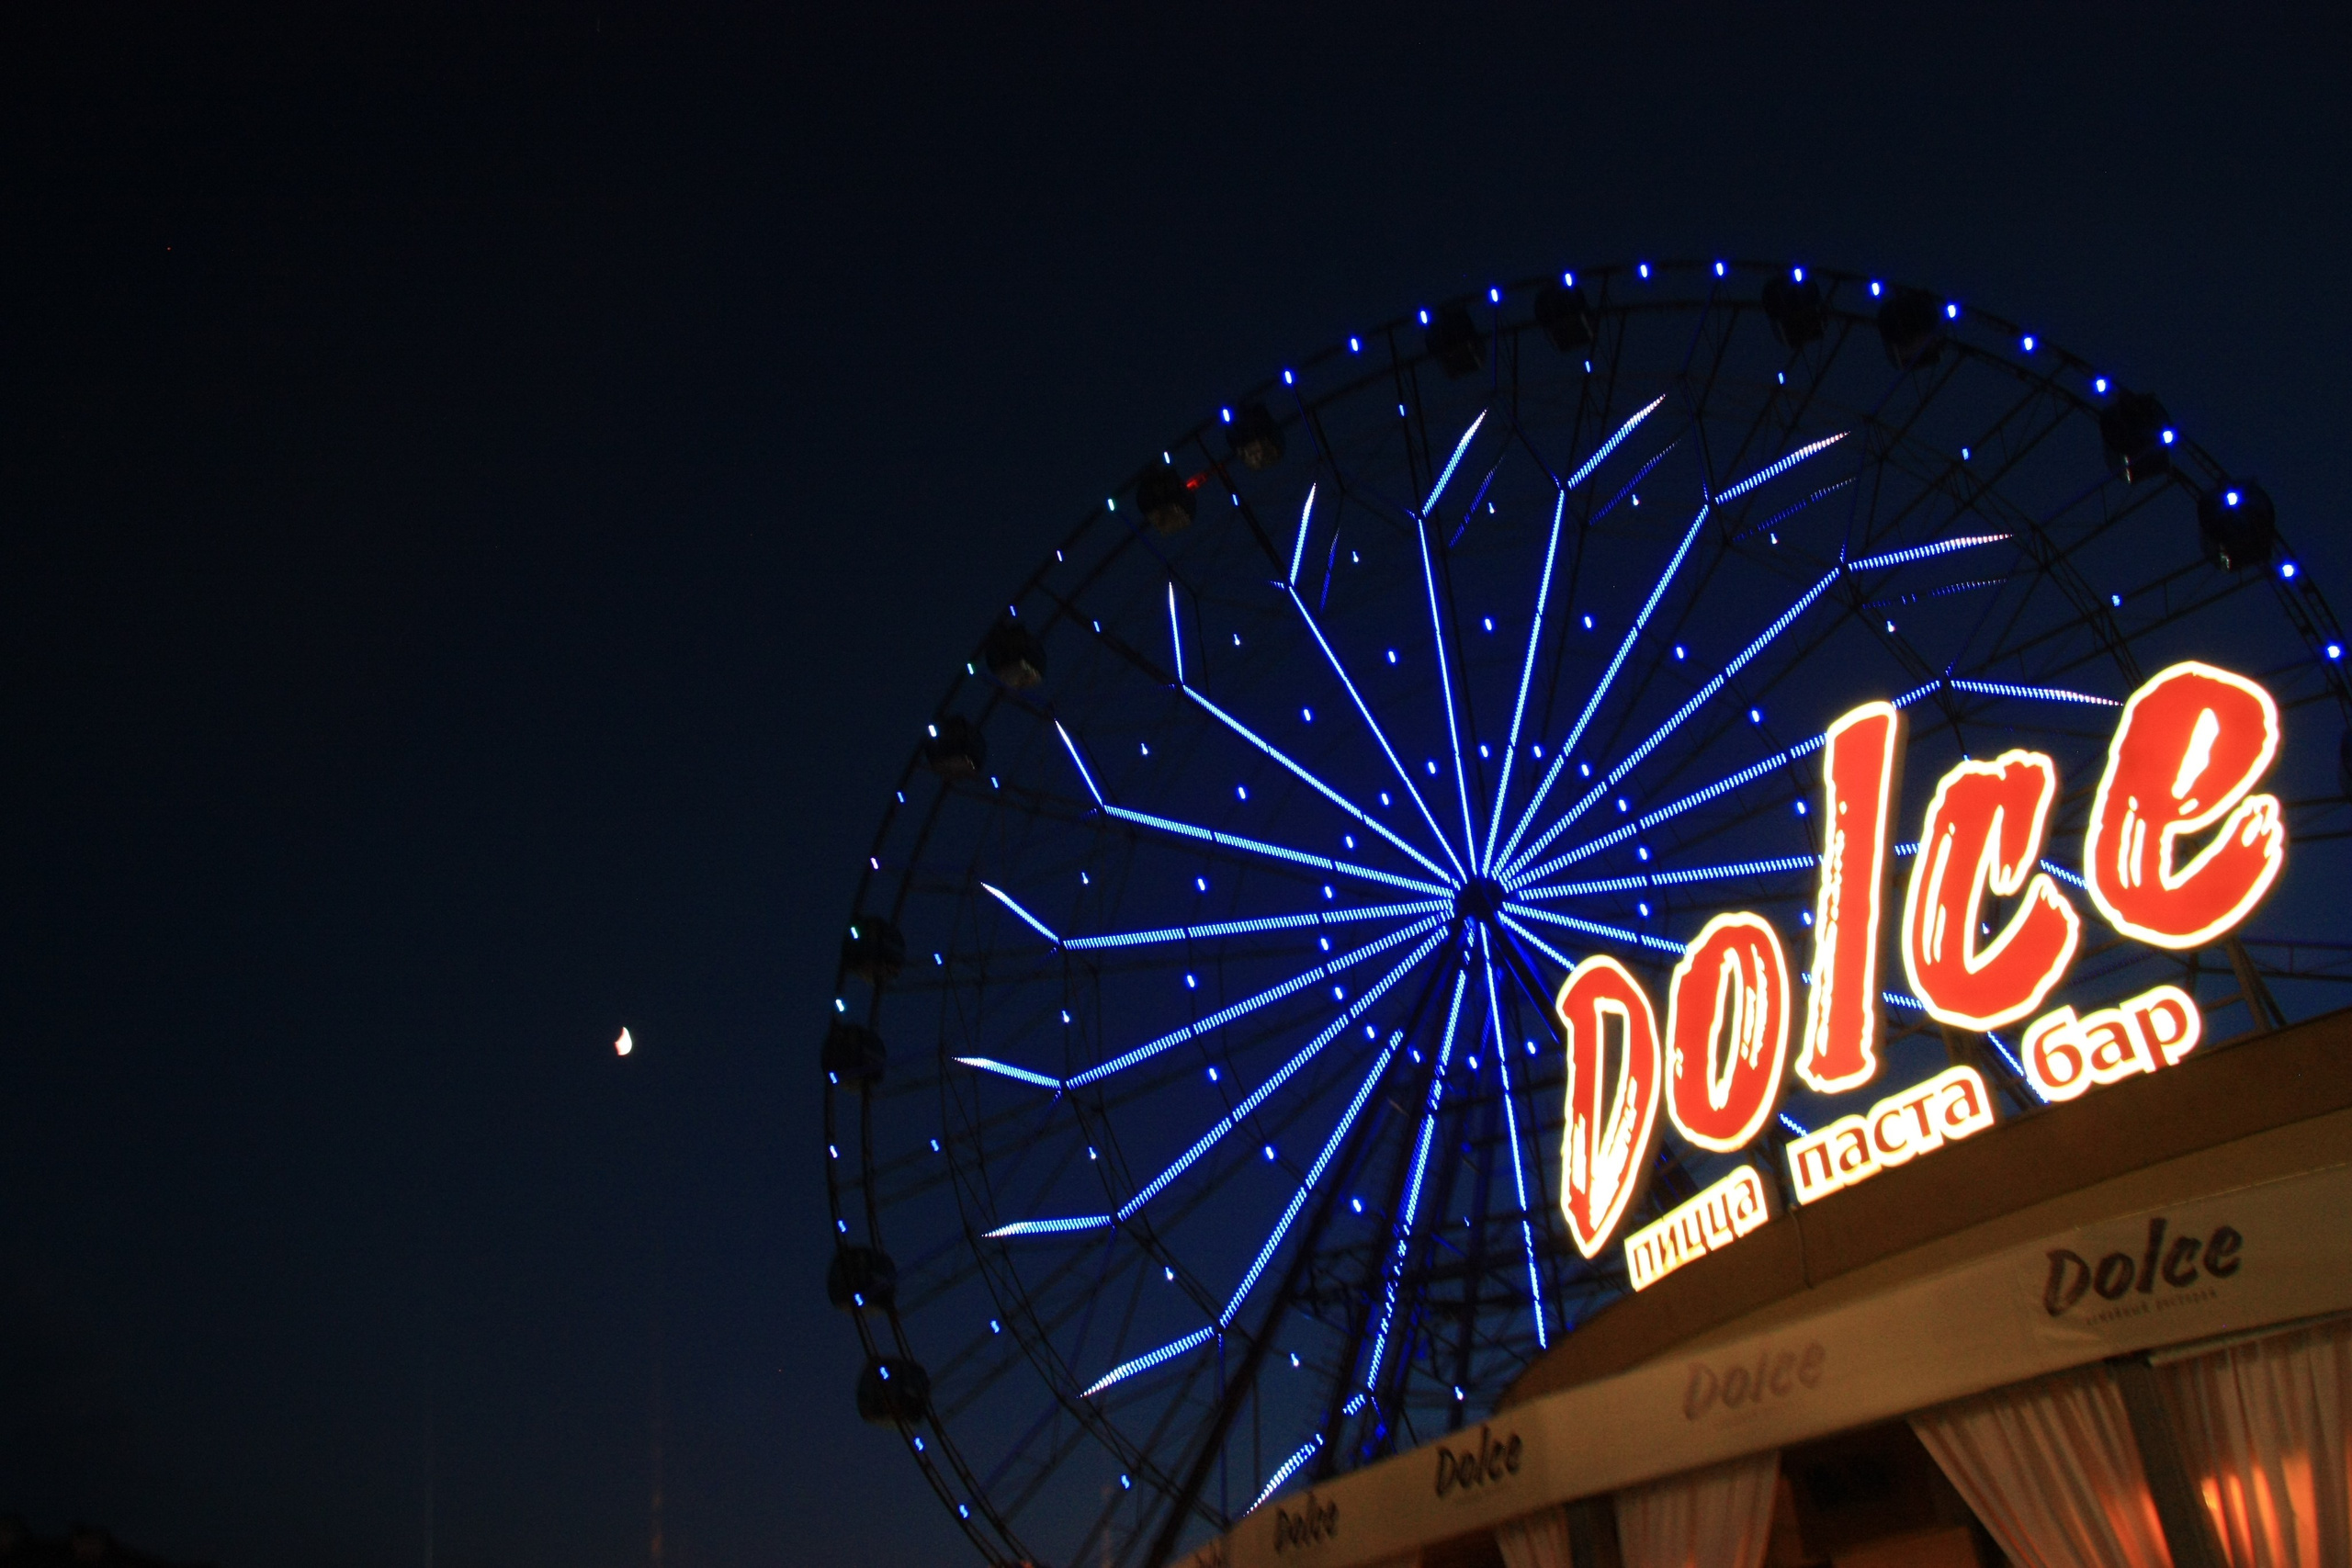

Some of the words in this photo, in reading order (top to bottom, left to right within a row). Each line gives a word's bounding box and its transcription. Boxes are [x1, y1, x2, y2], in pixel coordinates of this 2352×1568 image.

[1556, 660, 2284, 1257] Dolce
[1626, 1168, 1768, 1291] пицца
[1790, 1068, 1992, 1203] паста
[2023, 987, 2199, 1099] бар
[2042, 1216, 2244, 1317] Dolce
[1682, 1341, 1826, 1421] Dolce
[1435, 1423, 1523, 1499] Dolce
